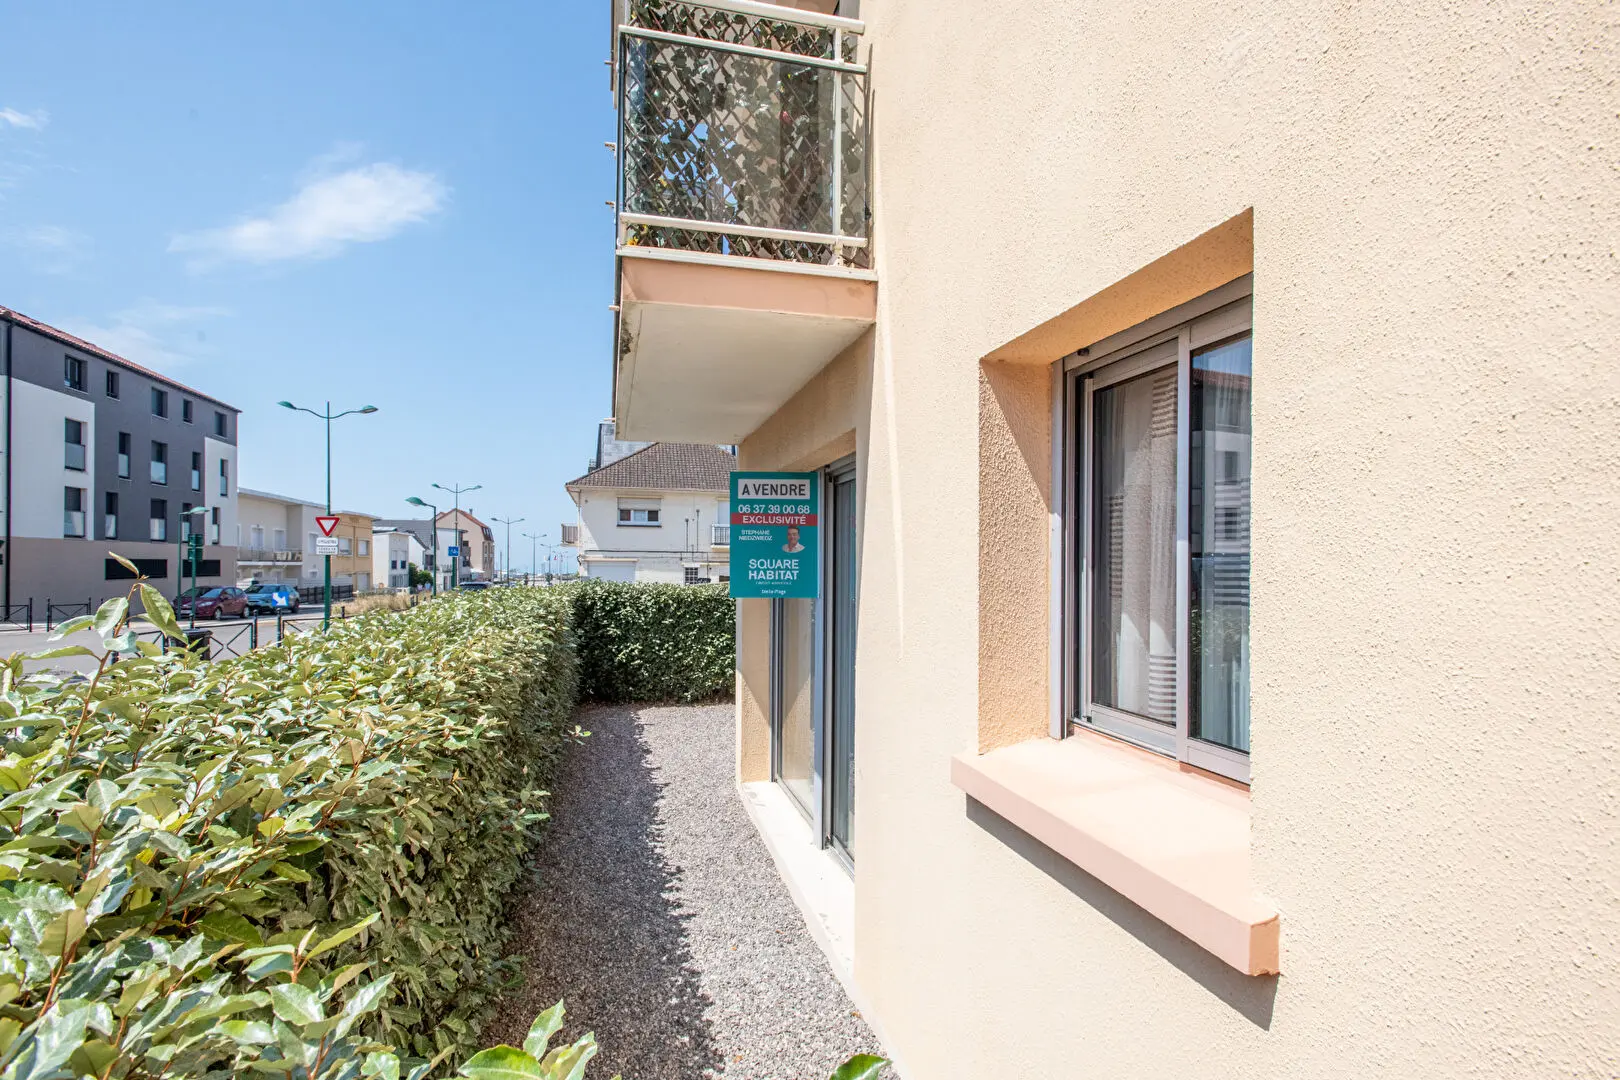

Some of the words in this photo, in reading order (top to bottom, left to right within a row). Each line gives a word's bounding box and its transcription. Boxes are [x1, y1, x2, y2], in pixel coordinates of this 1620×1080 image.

[742, 483, 750, 496] A
[753, 483, 806, 496] VENDRE
[738, 504, 751, 514] 06
[753, 504, 766, 514] 37
[768, 504, 780, 514] 39
[782, 504, 795, 514] 00
[797, 504, 810, 514] 68
[742, 515, 806, 525] EXCLUSIVITÉ
[748, 559, 799, 569] SQUARE
[748, 570, 799, 580] HABITAT
